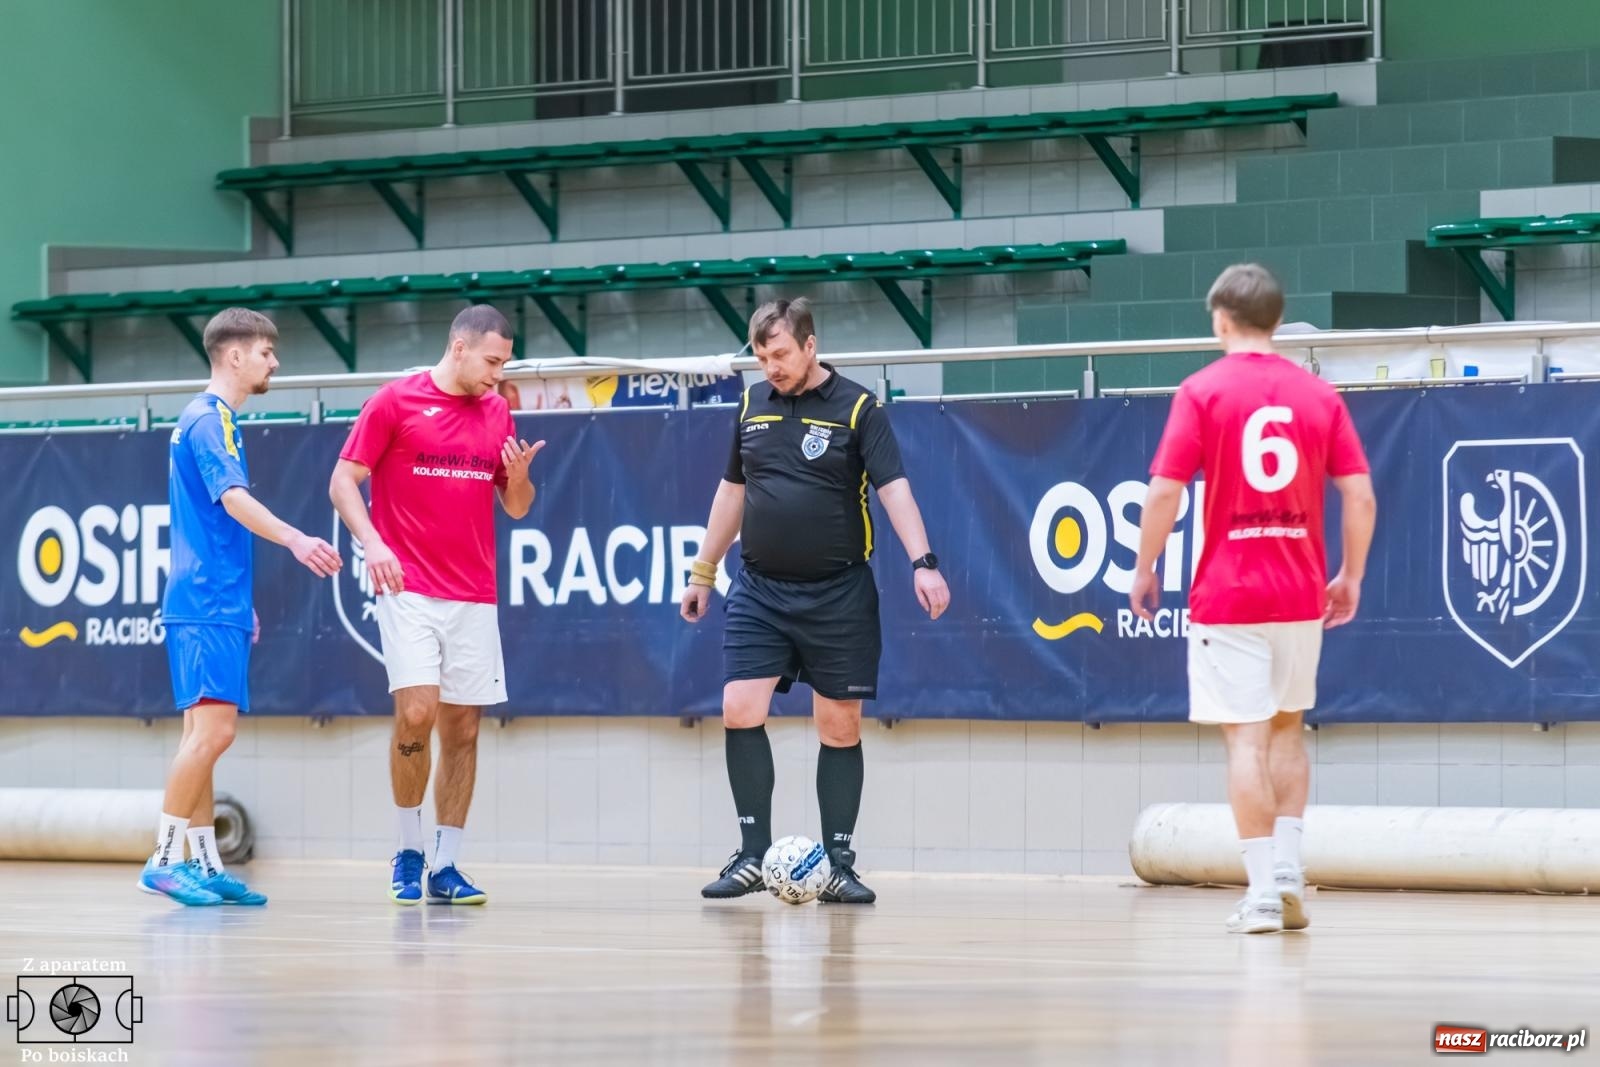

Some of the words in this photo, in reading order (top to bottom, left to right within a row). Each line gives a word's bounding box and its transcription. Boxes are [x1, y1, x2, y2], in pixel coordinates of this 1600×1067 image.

[413, 466, 451, 478] KOLORZ
[1242, 405, 1299, 493] 6
[1029, 480, 1206, 594] OSi
